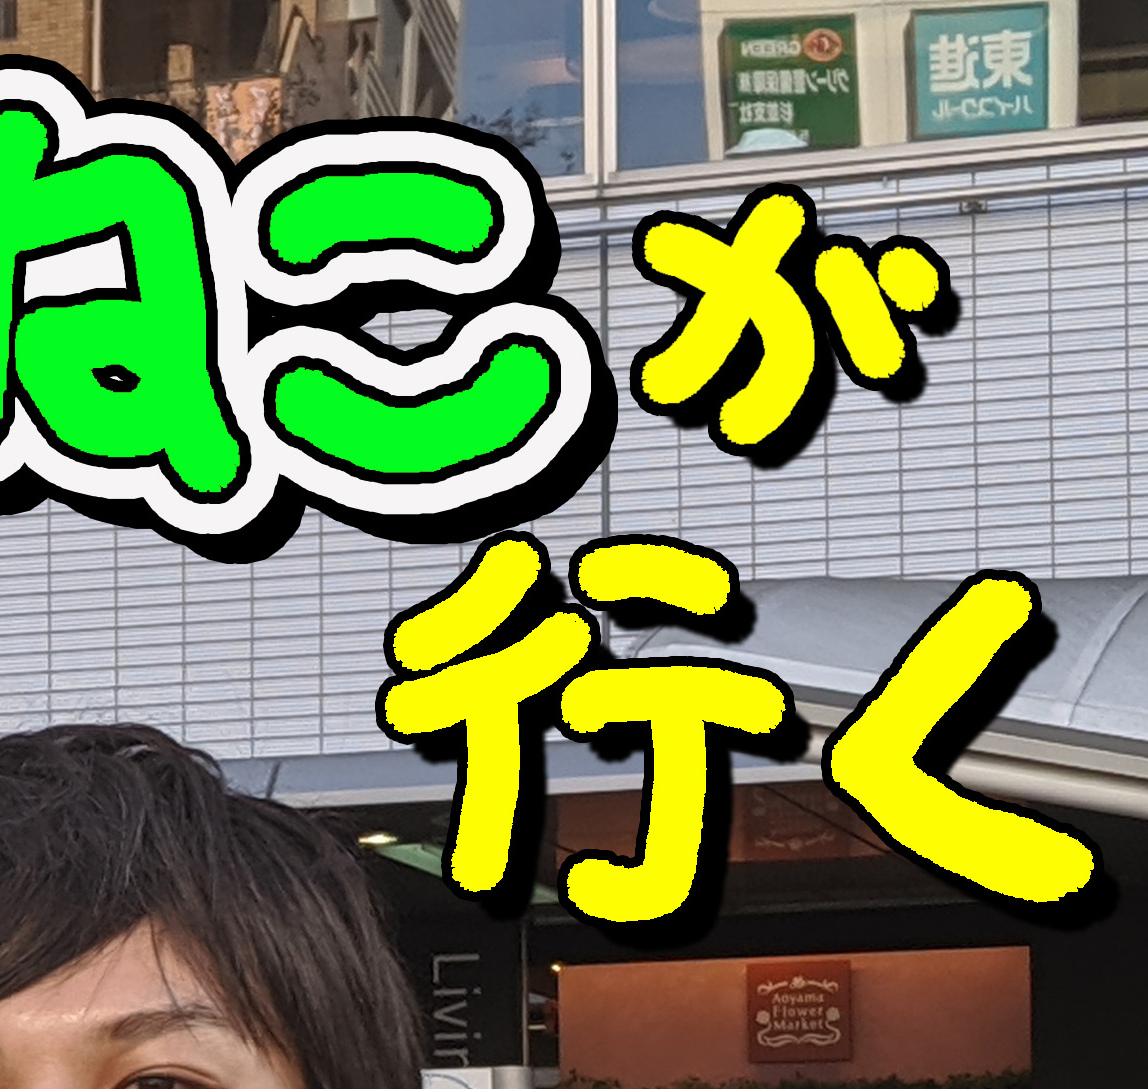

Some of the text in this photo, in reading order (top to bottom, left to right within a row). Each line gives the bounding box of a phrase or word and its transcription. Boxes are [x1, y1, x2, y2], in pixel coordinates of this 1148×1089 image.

[772, 992, 825, 1005] Aoyama
[773, 1005, 824, 1018] Flower
[773, 1018, 824, 1031] Market
